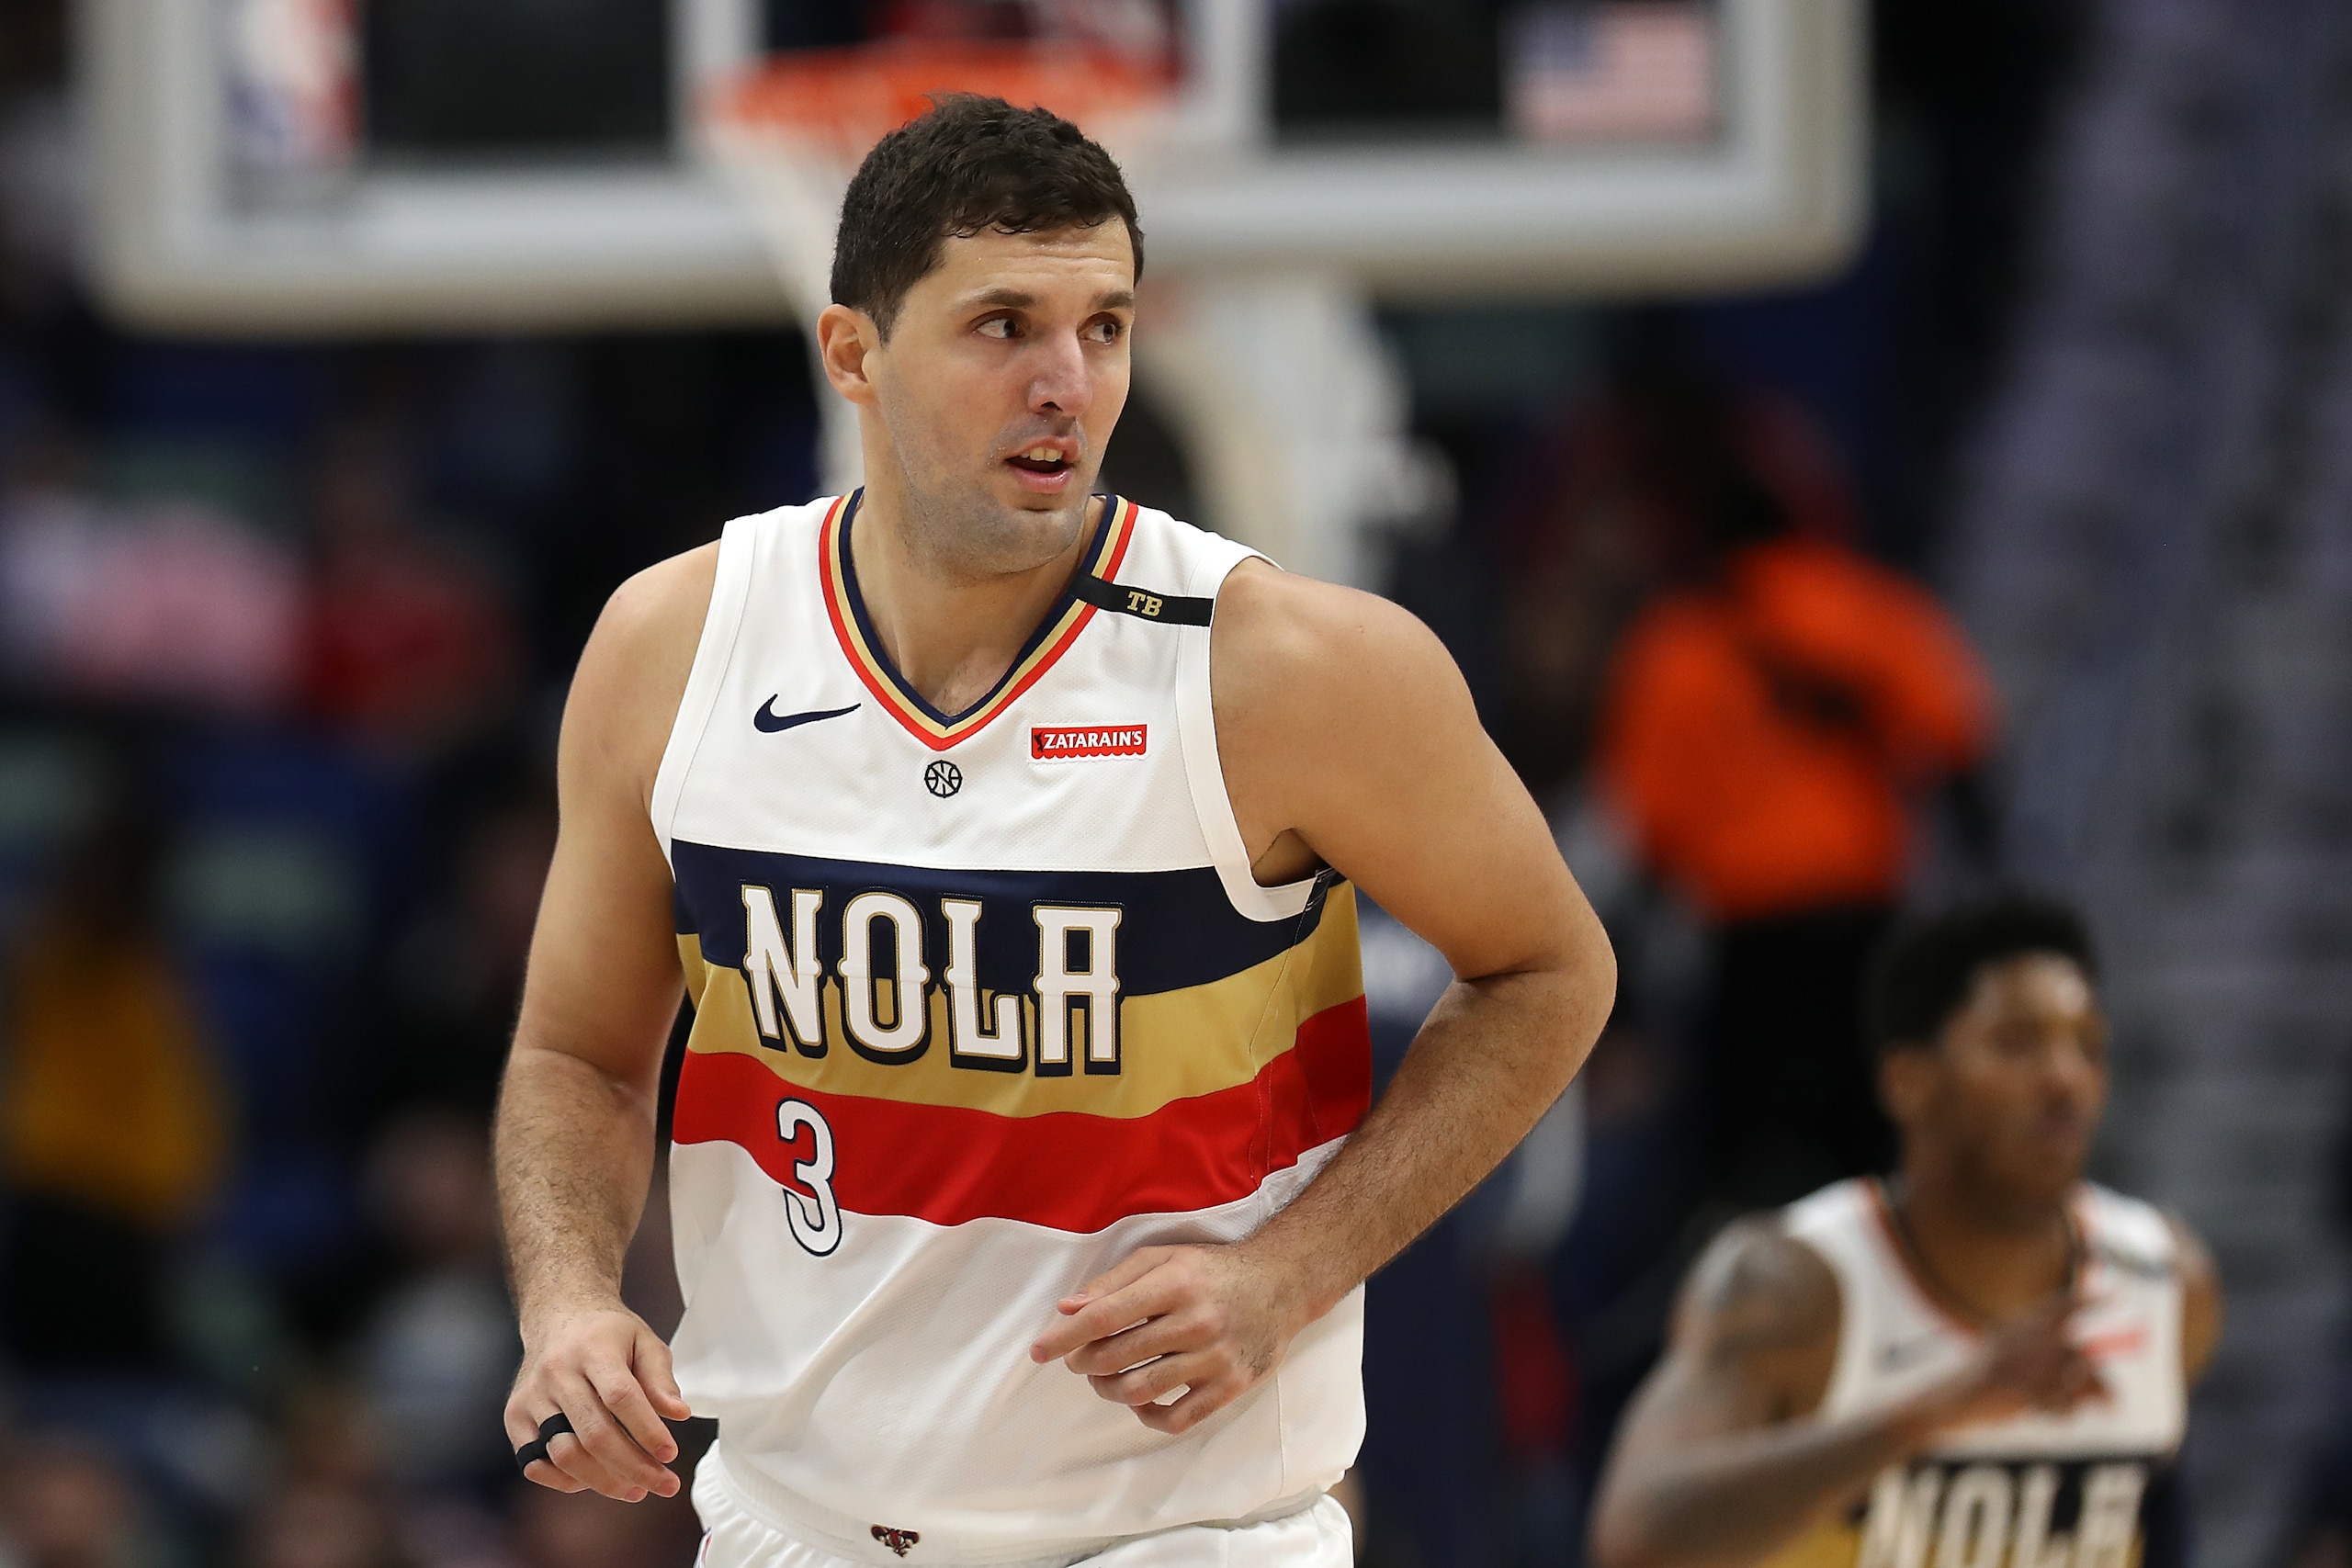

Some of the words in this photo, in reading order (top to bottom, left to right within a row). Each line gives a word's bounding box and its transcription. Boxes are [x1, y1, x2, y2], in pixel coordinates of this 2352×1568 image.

[1126, 591, 1163, 617] TB
[1043, 730, 1143, 750] ZATARAIN'S
[741, 884, 1124, 1077] NOLA
[775, 1095, 843, 1258] 3
[1860, 1462, 2148, 1568] NOLA
